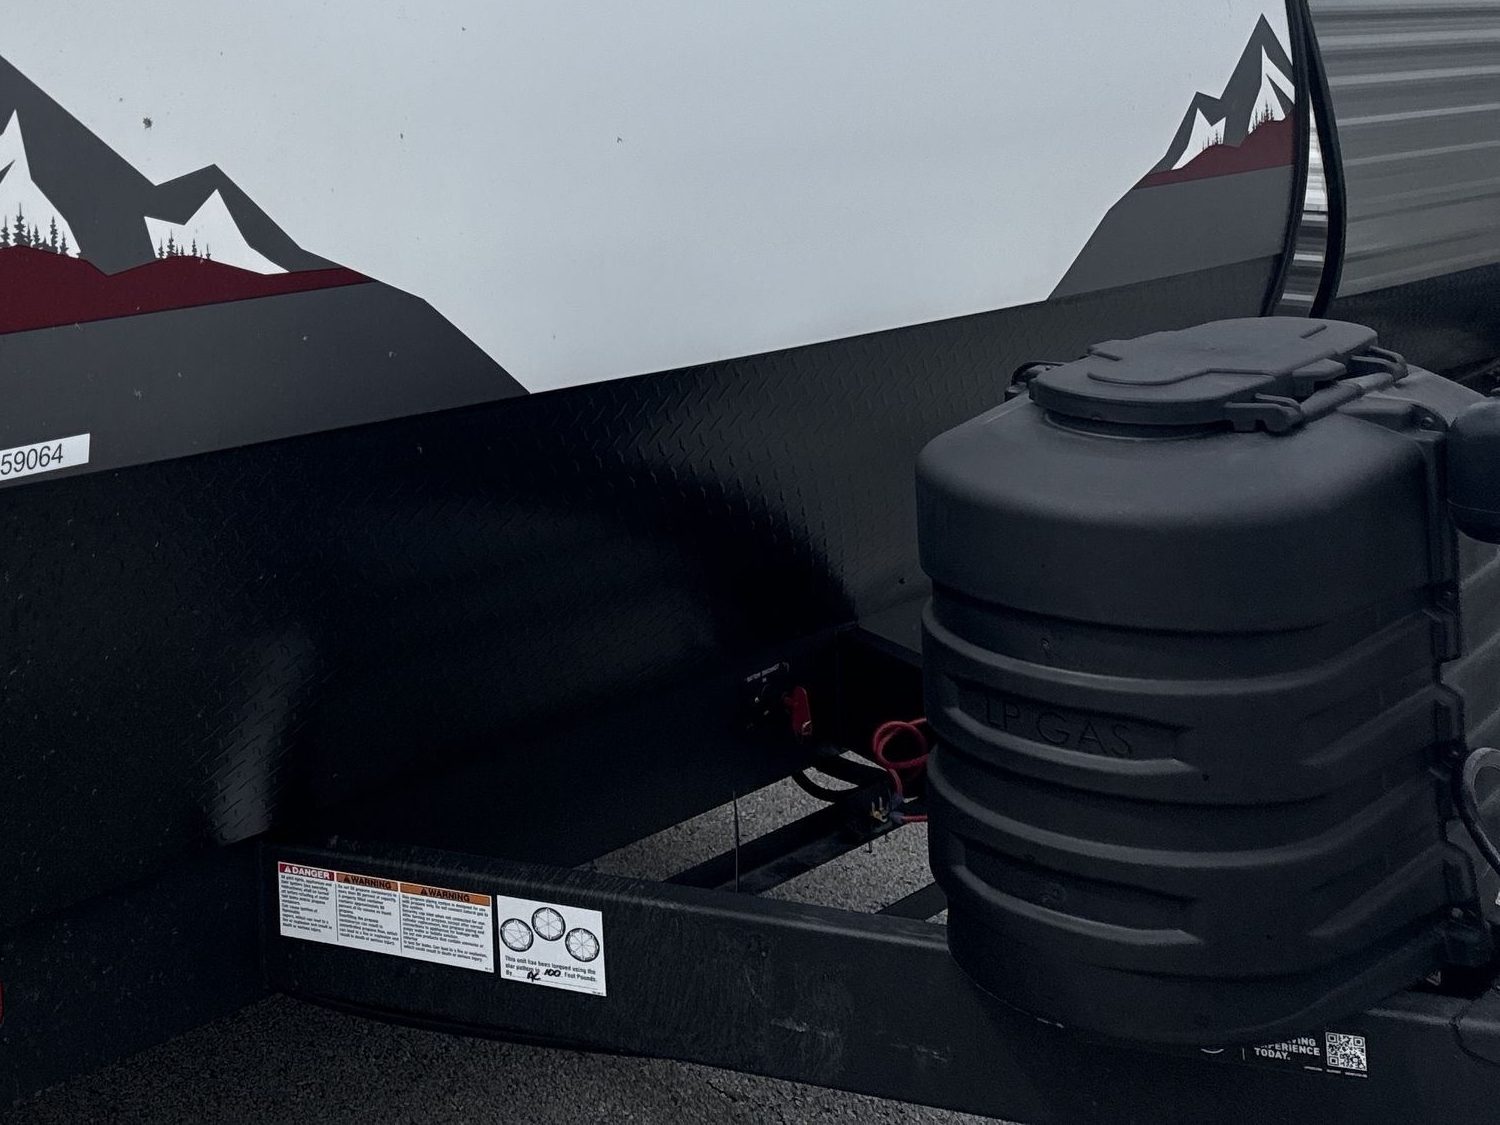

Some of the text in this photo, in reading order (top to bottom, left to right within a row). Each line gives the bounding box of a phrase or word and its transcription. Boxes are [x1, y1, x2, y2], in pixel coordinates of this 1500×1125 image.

[1037, 711, 1133, 757] GAS
[292, 866, 330, 880] DANGER
[351, 876, 392, 889] WARNING
[428, 888, 470, 902] WARNING
[1254, 1047, 1290, 1060] TODAY.
